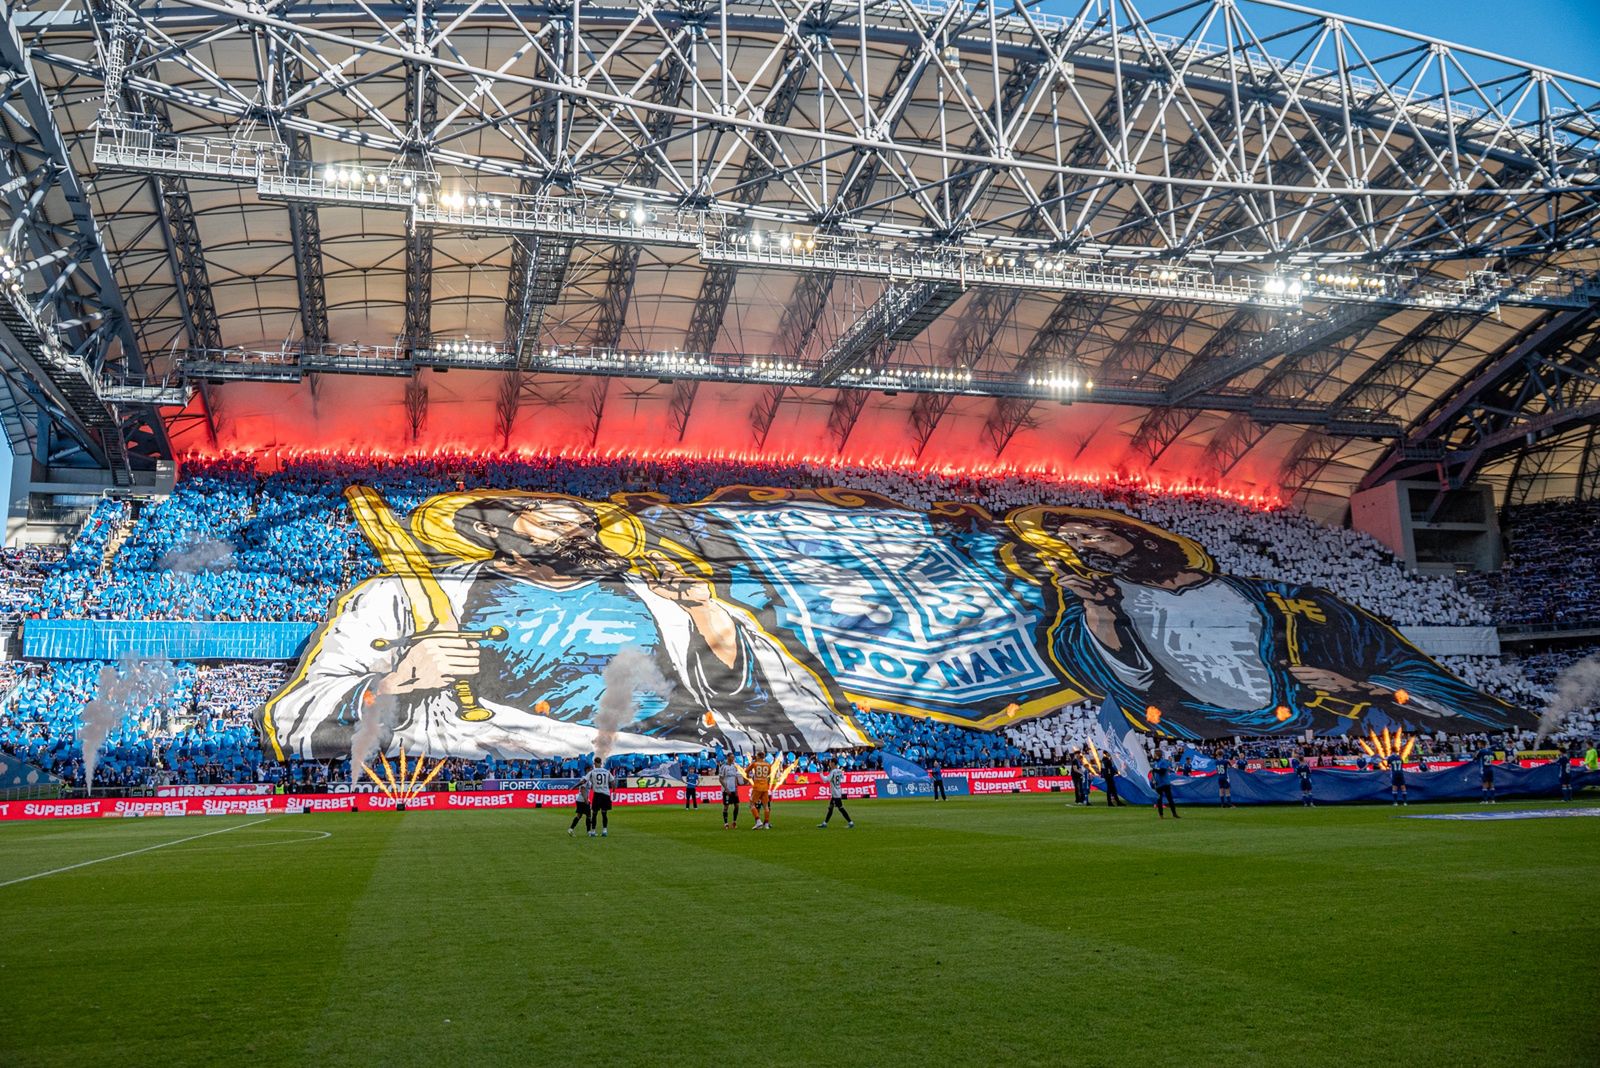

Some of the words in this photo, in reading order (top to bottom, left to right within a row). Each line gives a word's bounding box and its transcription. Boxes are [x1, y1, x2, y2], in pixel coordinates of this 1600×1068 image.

[833, 641, 1027, 687] POZNAŃ
[755, 766, 769, 777] 89
[595, 773, 606, 786] 91
[974, 780, 1027, 792] SUPERBET
[448, 794, 514, 807] SUPERBET
[526, 793, 576, 805] SUPERB
[611, 790, 665, 803] UPERBET
[24, 802, 101, 816] SUPERBET
[115, 801, 188, 814] SUPERBET
[202, 799, 273, 811] SUPERBET
[287, 797, 356, 810] SUPERBET
